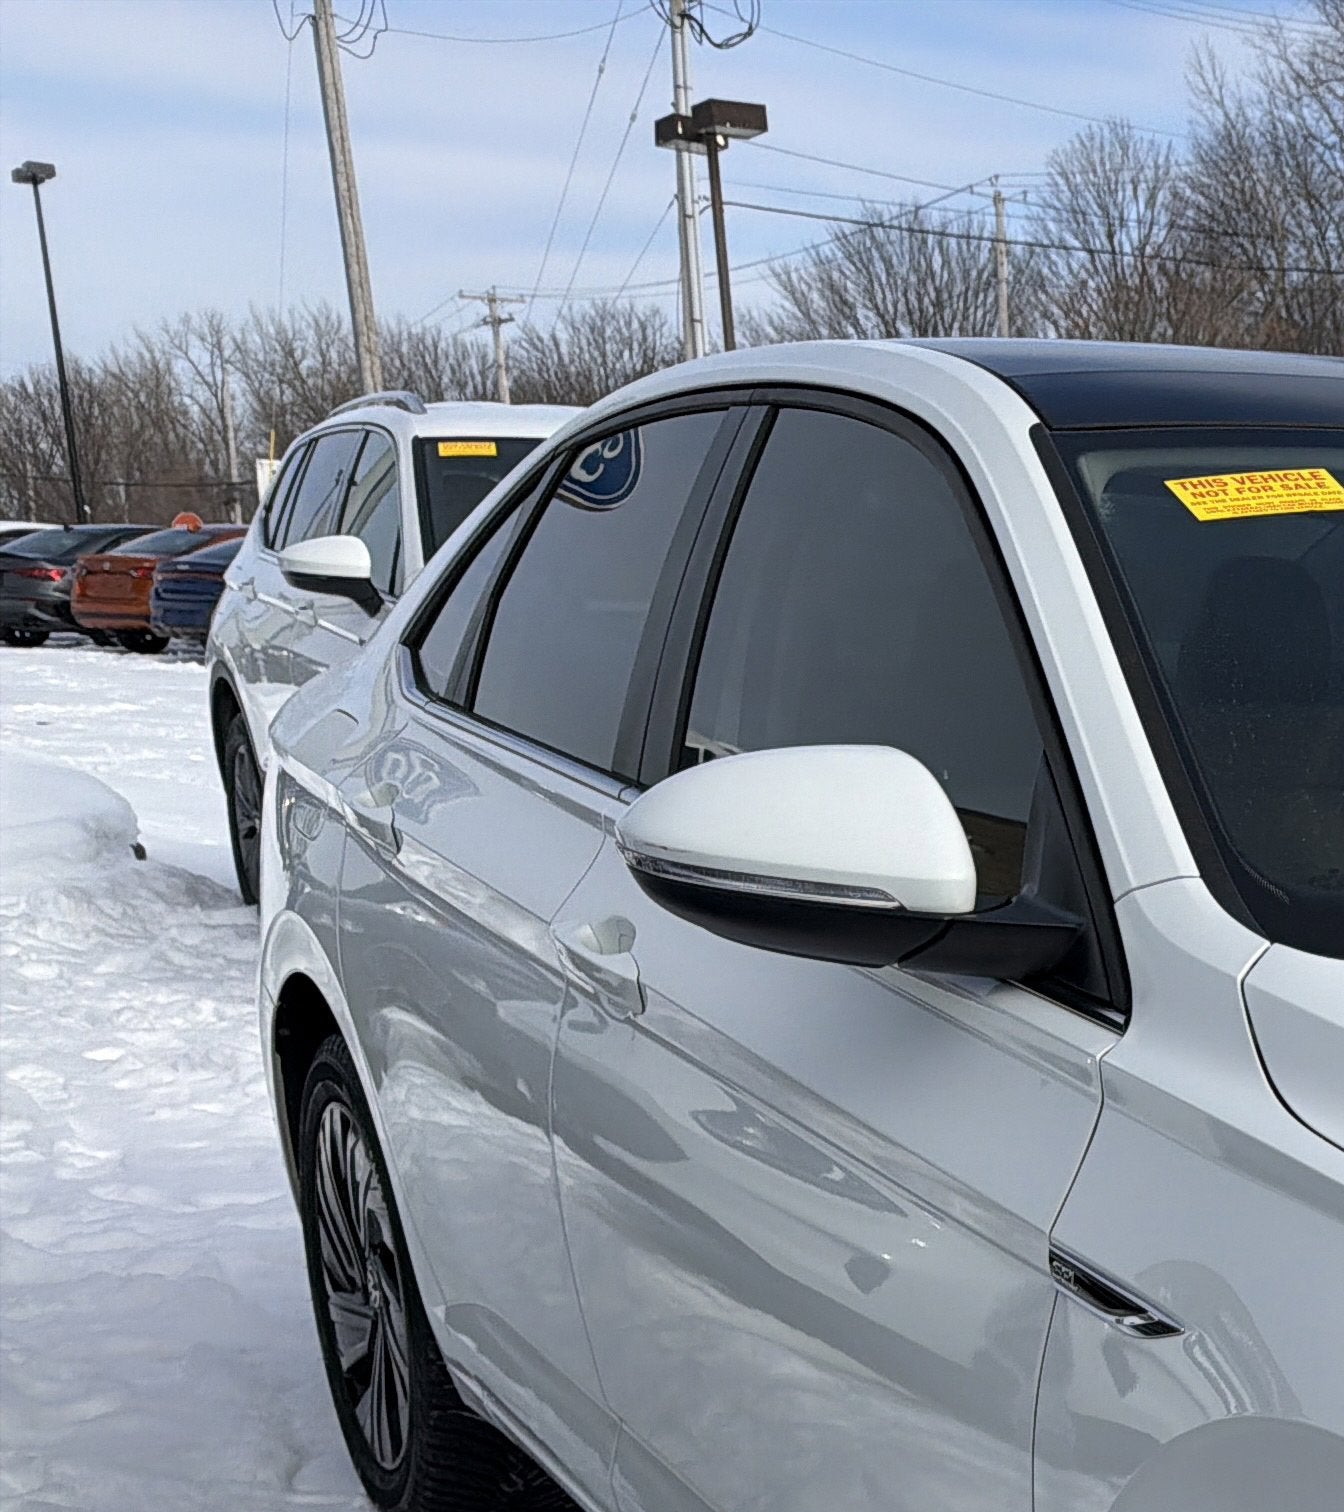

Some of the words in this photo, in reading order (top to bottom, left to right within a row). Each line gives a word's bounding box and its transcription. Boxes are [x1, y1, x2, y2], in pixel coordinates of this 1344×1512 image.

[1174, 478, 1228, 491] THIS
[1230, 471, 1326, 485] VEHICLE
[1190, 488, 1229, 499] NOT
[1235, 485, 1276, 495] FOR
[1280, 481, 1330, 491] SALE
